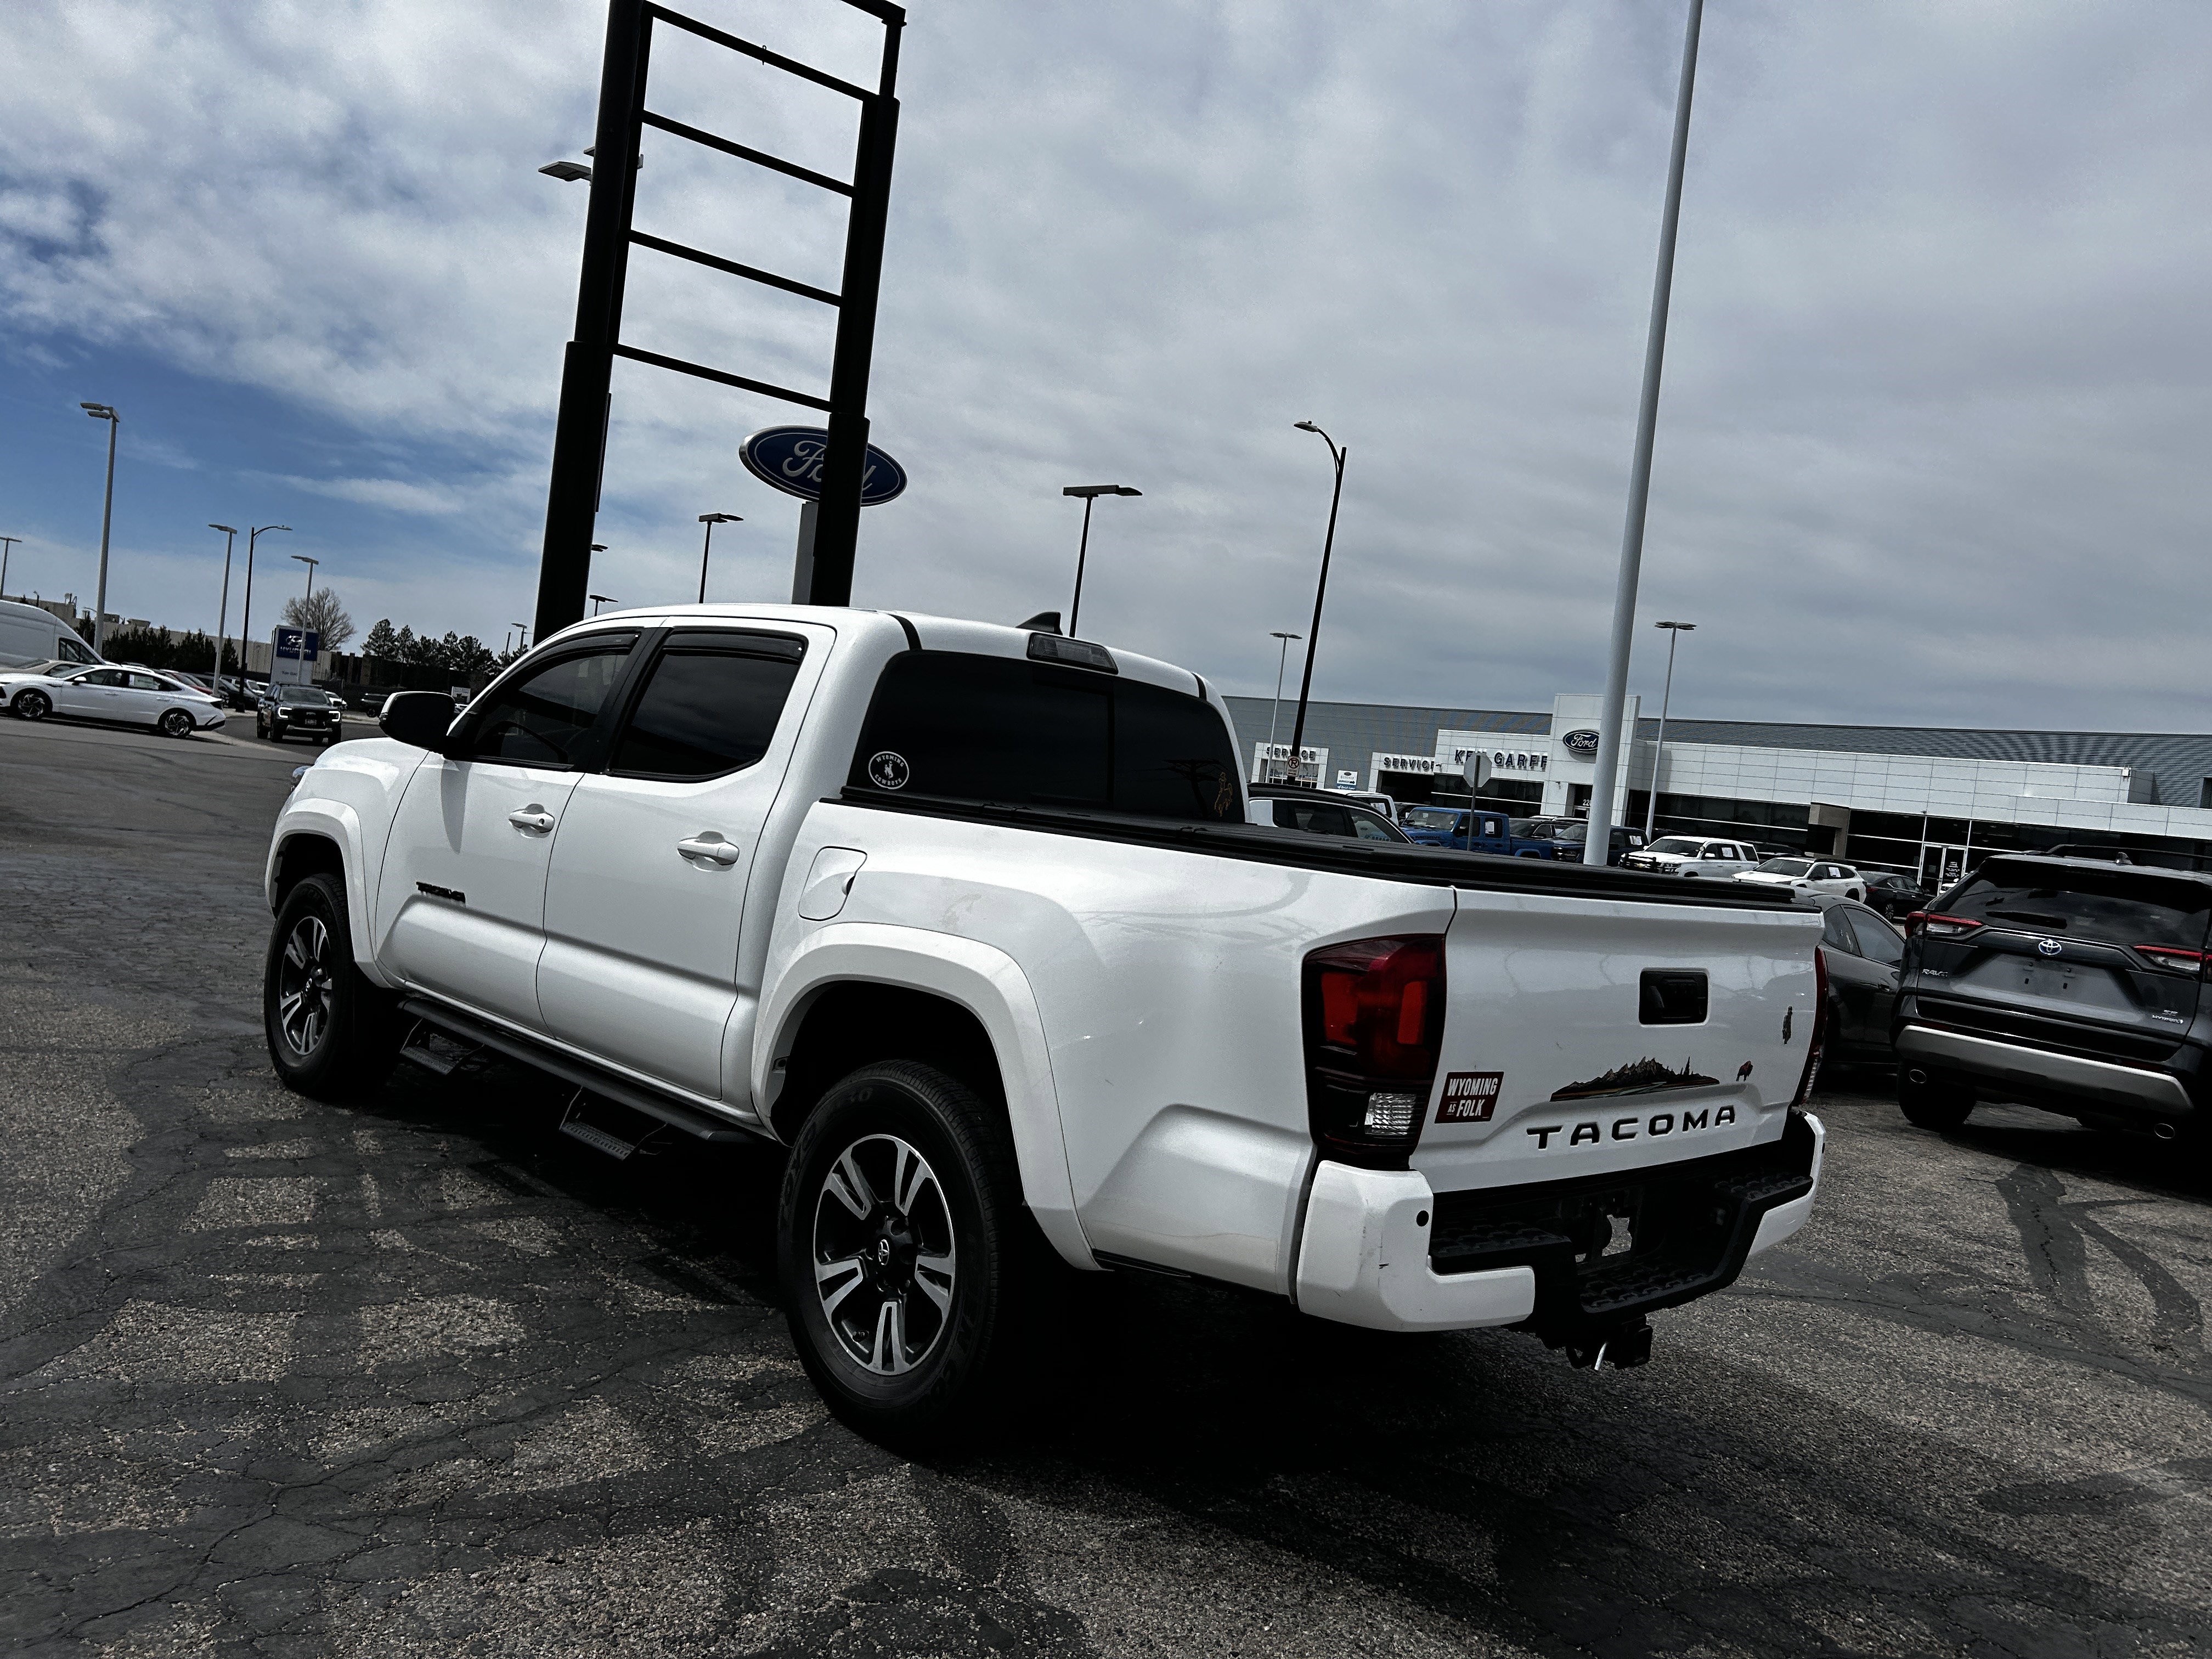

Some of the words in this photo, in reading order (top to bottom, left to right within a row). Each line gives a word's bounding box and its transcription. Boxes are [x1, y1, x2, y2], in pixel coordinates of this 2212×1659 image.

[1571, 733, 1598, 748] Ford
[876, 755, 904, 767] WYOMING
[874, 774, 902, 786] COWBOYS
[1447, 1078, 1498, 1096] WYOMING
[1447, 1103, 1457, 1113] AS
[1456, 1099, 1485, 1117] FOLK
[1526, 1104, 1736, 1150] TACOMA
